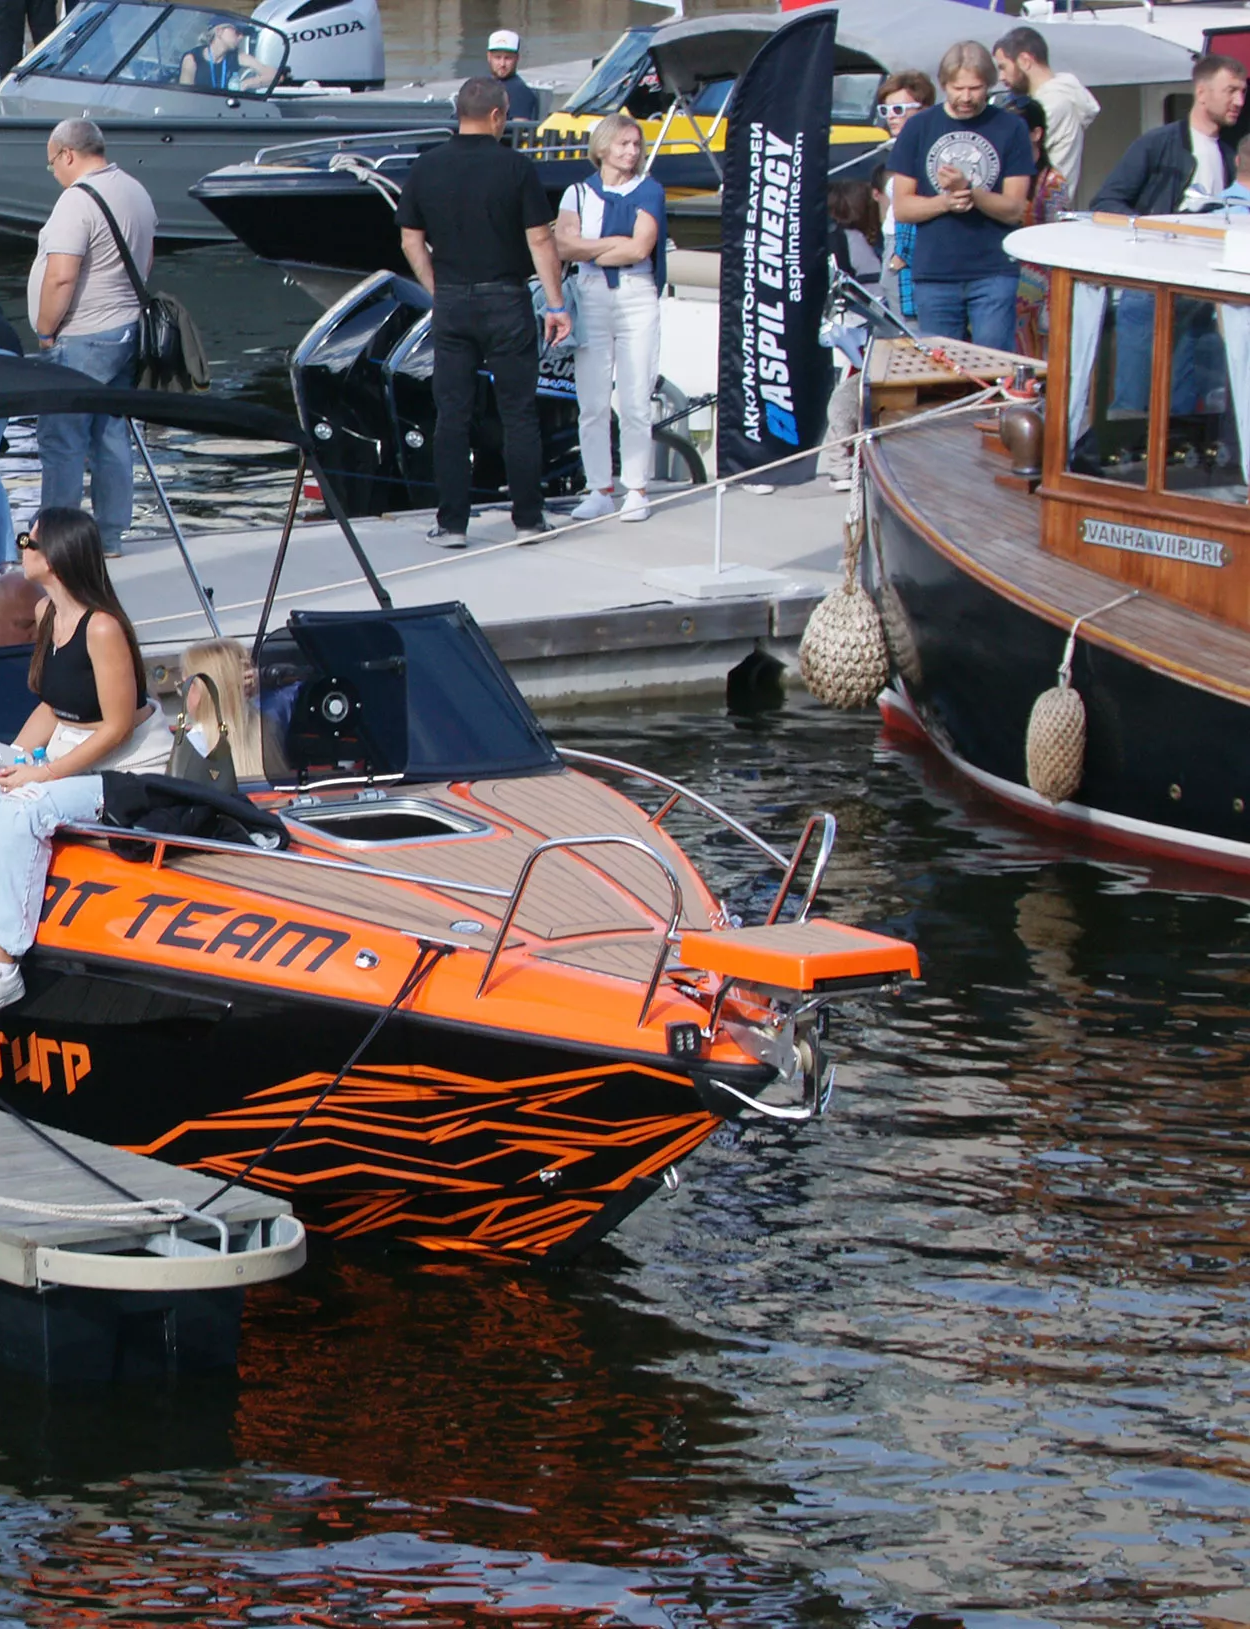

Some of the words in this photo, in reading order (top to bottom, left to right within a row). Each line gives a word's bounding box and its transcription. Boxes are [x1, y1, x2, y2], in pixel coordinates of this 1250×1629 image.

[283, 20, 366, 45] HONDA
[758, 130, 793, 290] ENERGY
[785, 132, 805, 302] aspilmarine.com
[741, 229, 761, 443] АККУМУЛЯТОРНЫЕ
[757, 301, 794, 412] ASPIL
[1088, 523, 1145, 550] VANHA
[1155, 535, 1218, 563] VIIPURI
[124, 893, 351, 972] TEAM
